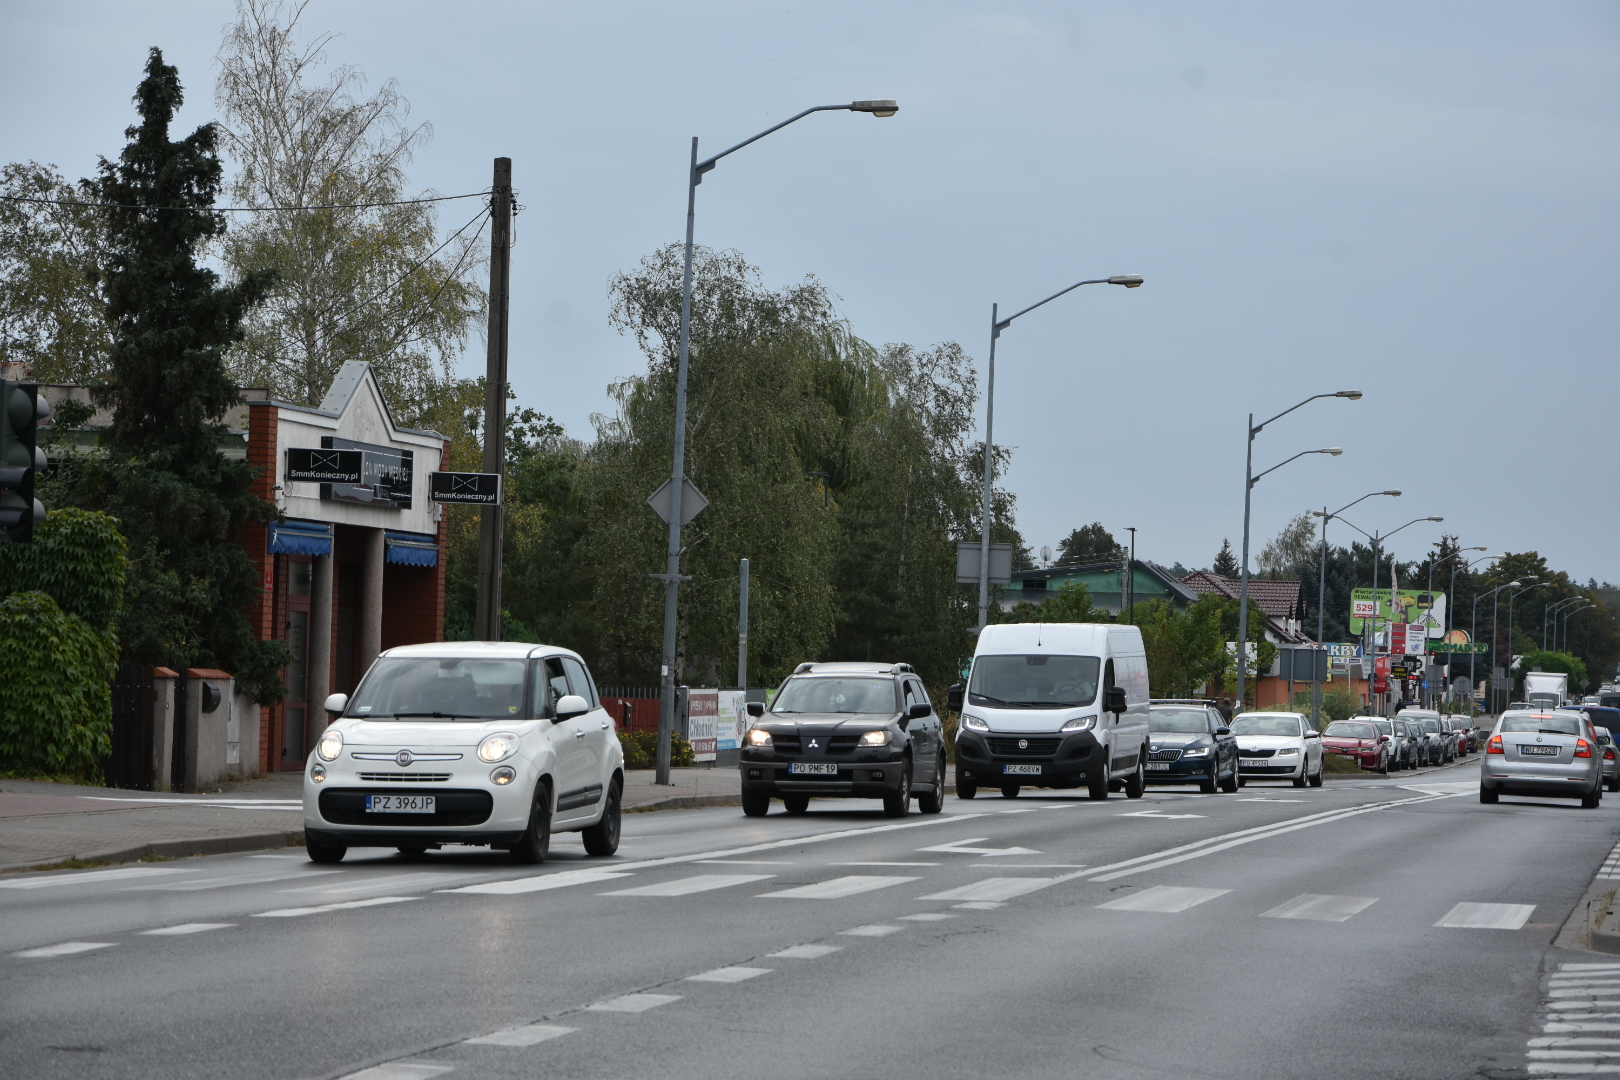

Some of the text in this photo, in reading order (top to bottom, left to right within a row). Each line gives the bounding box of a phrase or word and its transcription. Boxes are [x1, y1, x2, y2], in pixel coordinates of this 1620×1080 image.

[291, 469, 359, 481] SmmKonieczny.pl
[434, 491, 495, 502] SmmKonieczny.pl
[793, 763, 836, 774] PO 9MF19
[1007, 765, 1041, 773] PZ 468VW
[373, 796, 434, 810] PZ 396JP
